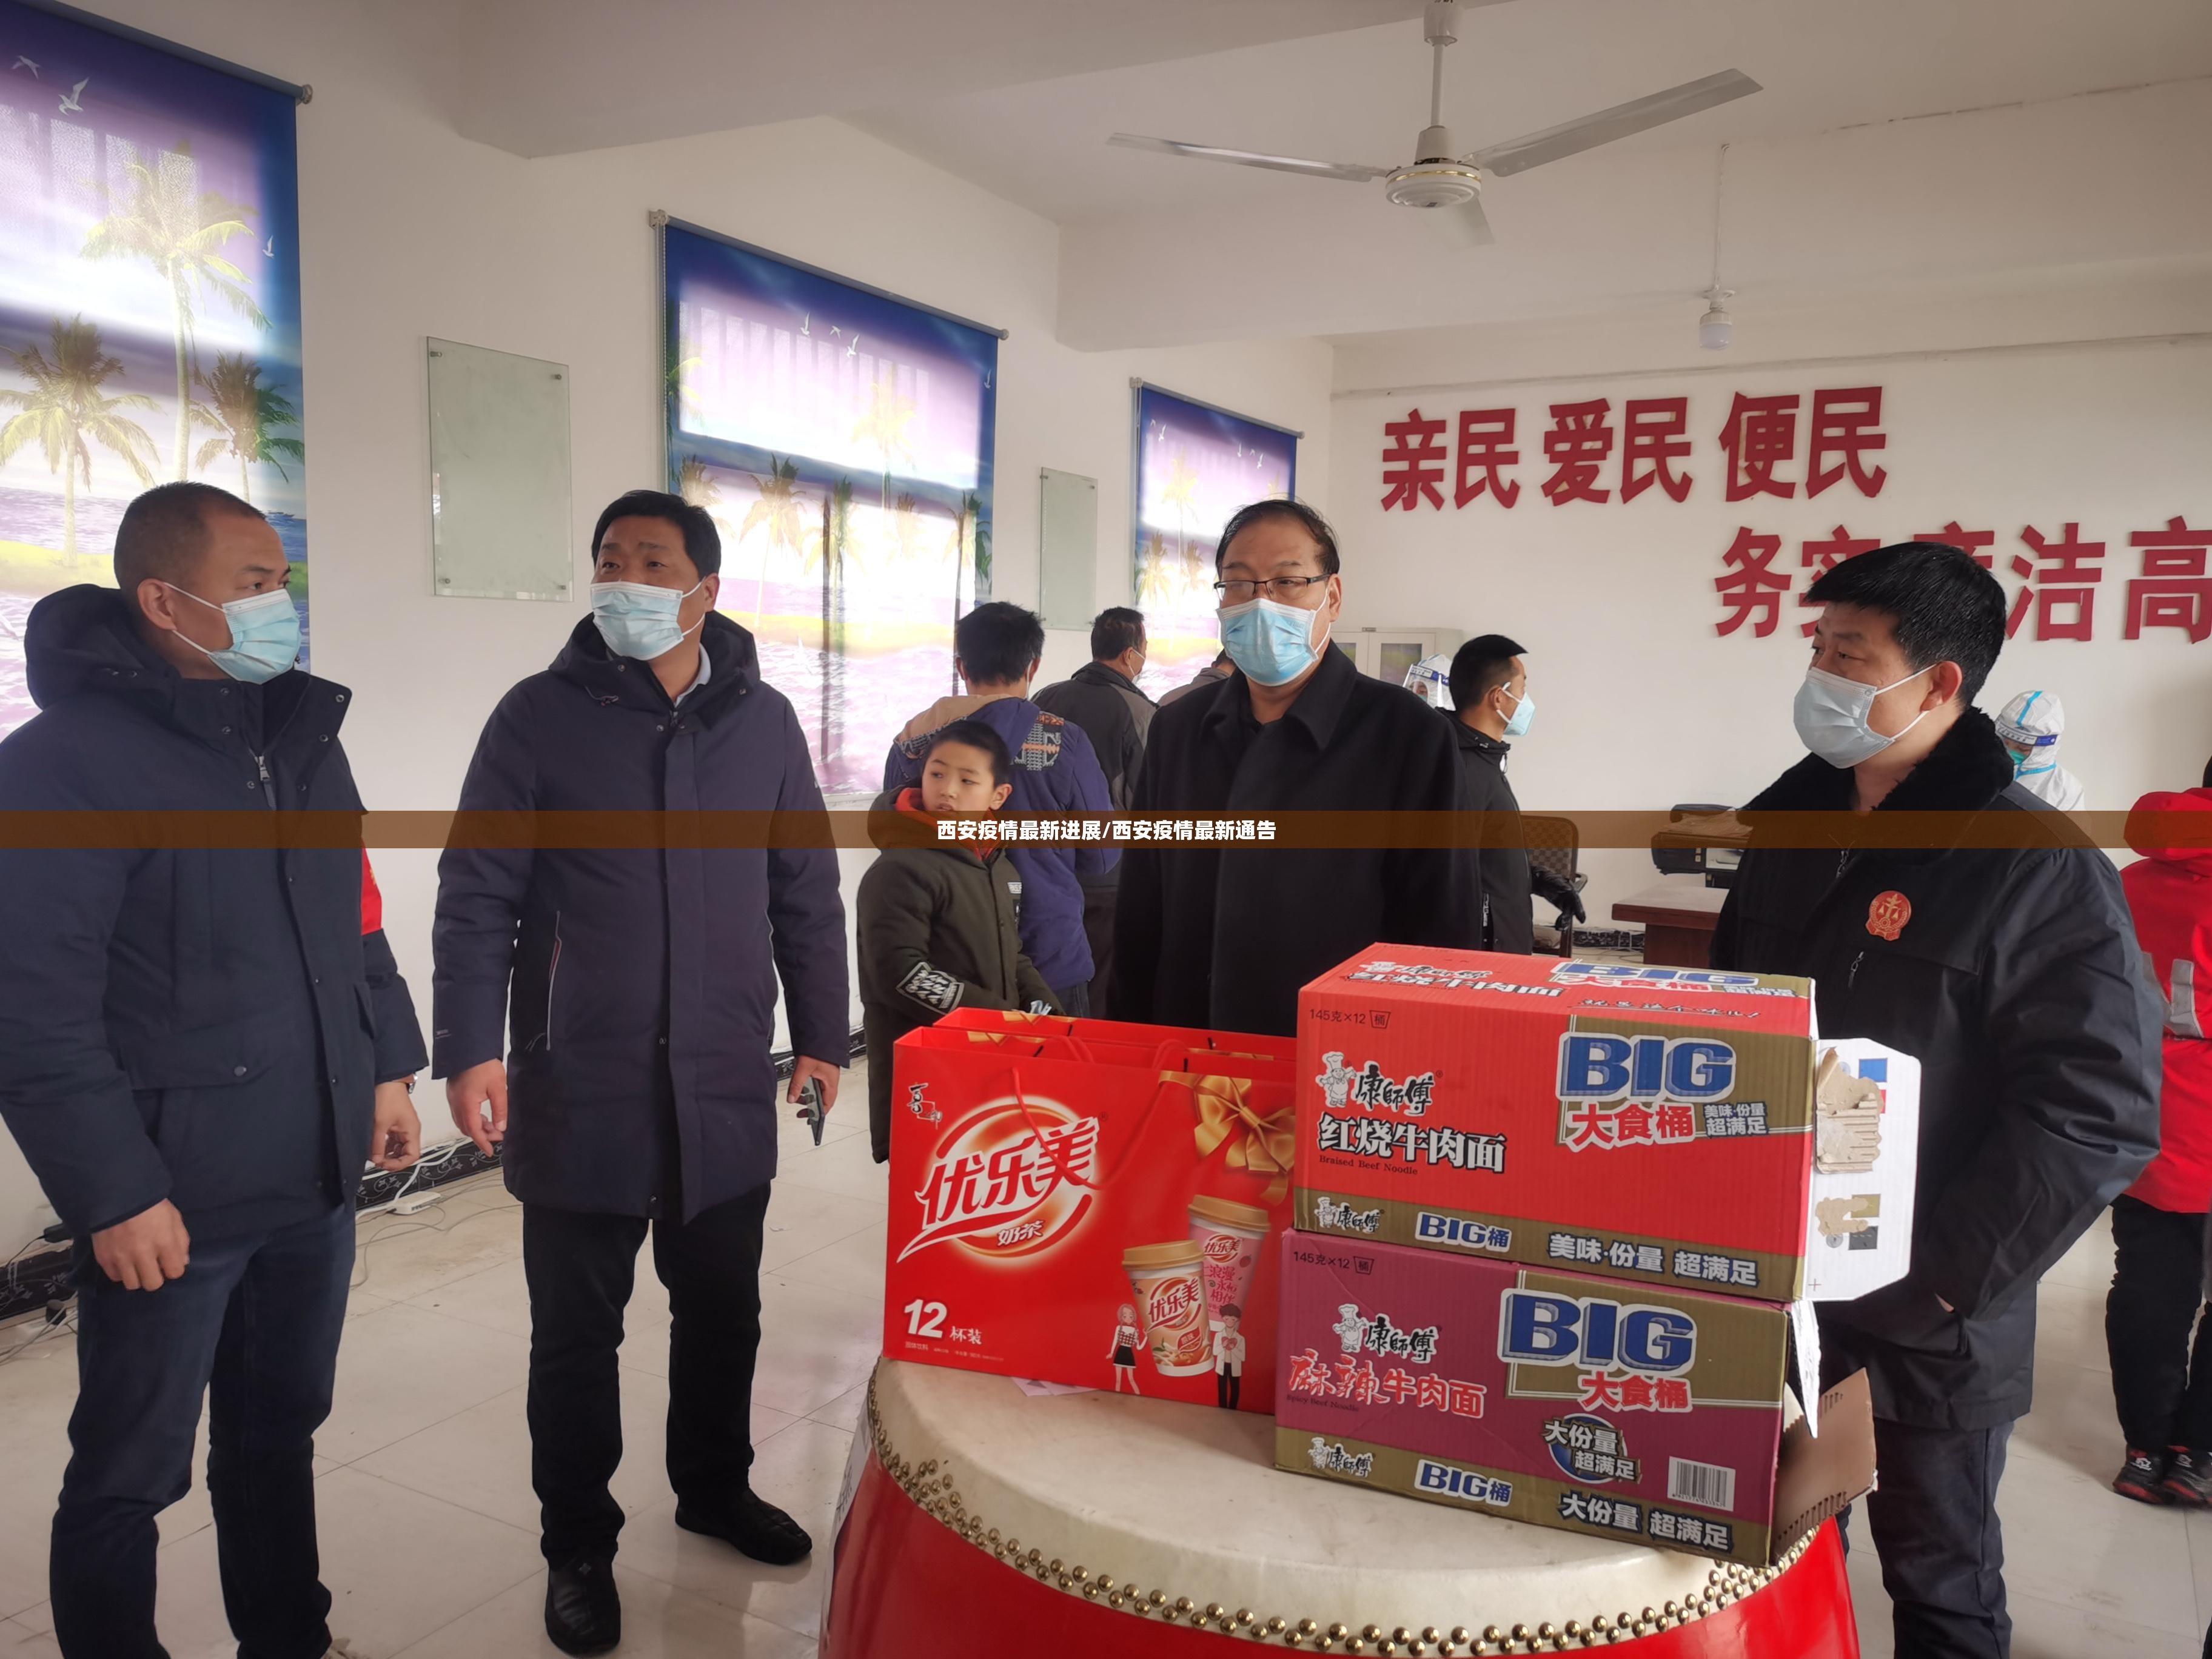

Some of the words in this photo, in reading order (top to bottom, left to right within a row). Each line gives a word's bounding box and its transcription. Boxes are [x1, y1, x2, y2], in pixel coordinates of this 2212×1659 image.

[1381, 408, 1521, 511] 亲民
[1541, 397, 1693, 506] 爱民
[1718, 386, 1887, 503] 便民
[1557, 963, 1758, 984] BIG
[1560, 1036, 1734, 1097] BIG
[1318, 1111, 1507, 1173] 红烧牛肉面
[1572, 1104, 1694, 1146] 大食桶
[1706, 1117, 1767, 1137] 超满足
[914, 1117, 1099, 1228] 优乐美
[1319, 1155, 1354, 1167] Braised
[1359, 1159, 1379, 1170] Beef
[1384, 1164, 1418, 1175] Noodle
[997, 1219, 1044, 1247] 奶茶
[1204, 1239, 1240, 1253] 优乐美
[1419, 1214, 1509, 1248] BIG桶
[1674, 1251, 1757, 1286] 超满足
[1148, 1277, 1199, 1323] 优乐美
[904, 1299, 948, 1339] 12
[950, 1326, 982, 1345] 杯装
[1502, 1293, 1694, 1372] BIG
[1288, 1349, 1487, 1419] 麻辣牛肉面
[1580, 1370, 1689, 1409] 大食桶
[1545, 1420, 1618, 1456] 大份量
[1419, 1462, 1512, 1503] BIG桶
[1574, 1450, 1635, 1480] 超满足
[1561, 1493, 1639, 1531] 大份量
[1649, 1510, 1729, 1550] 超满足
